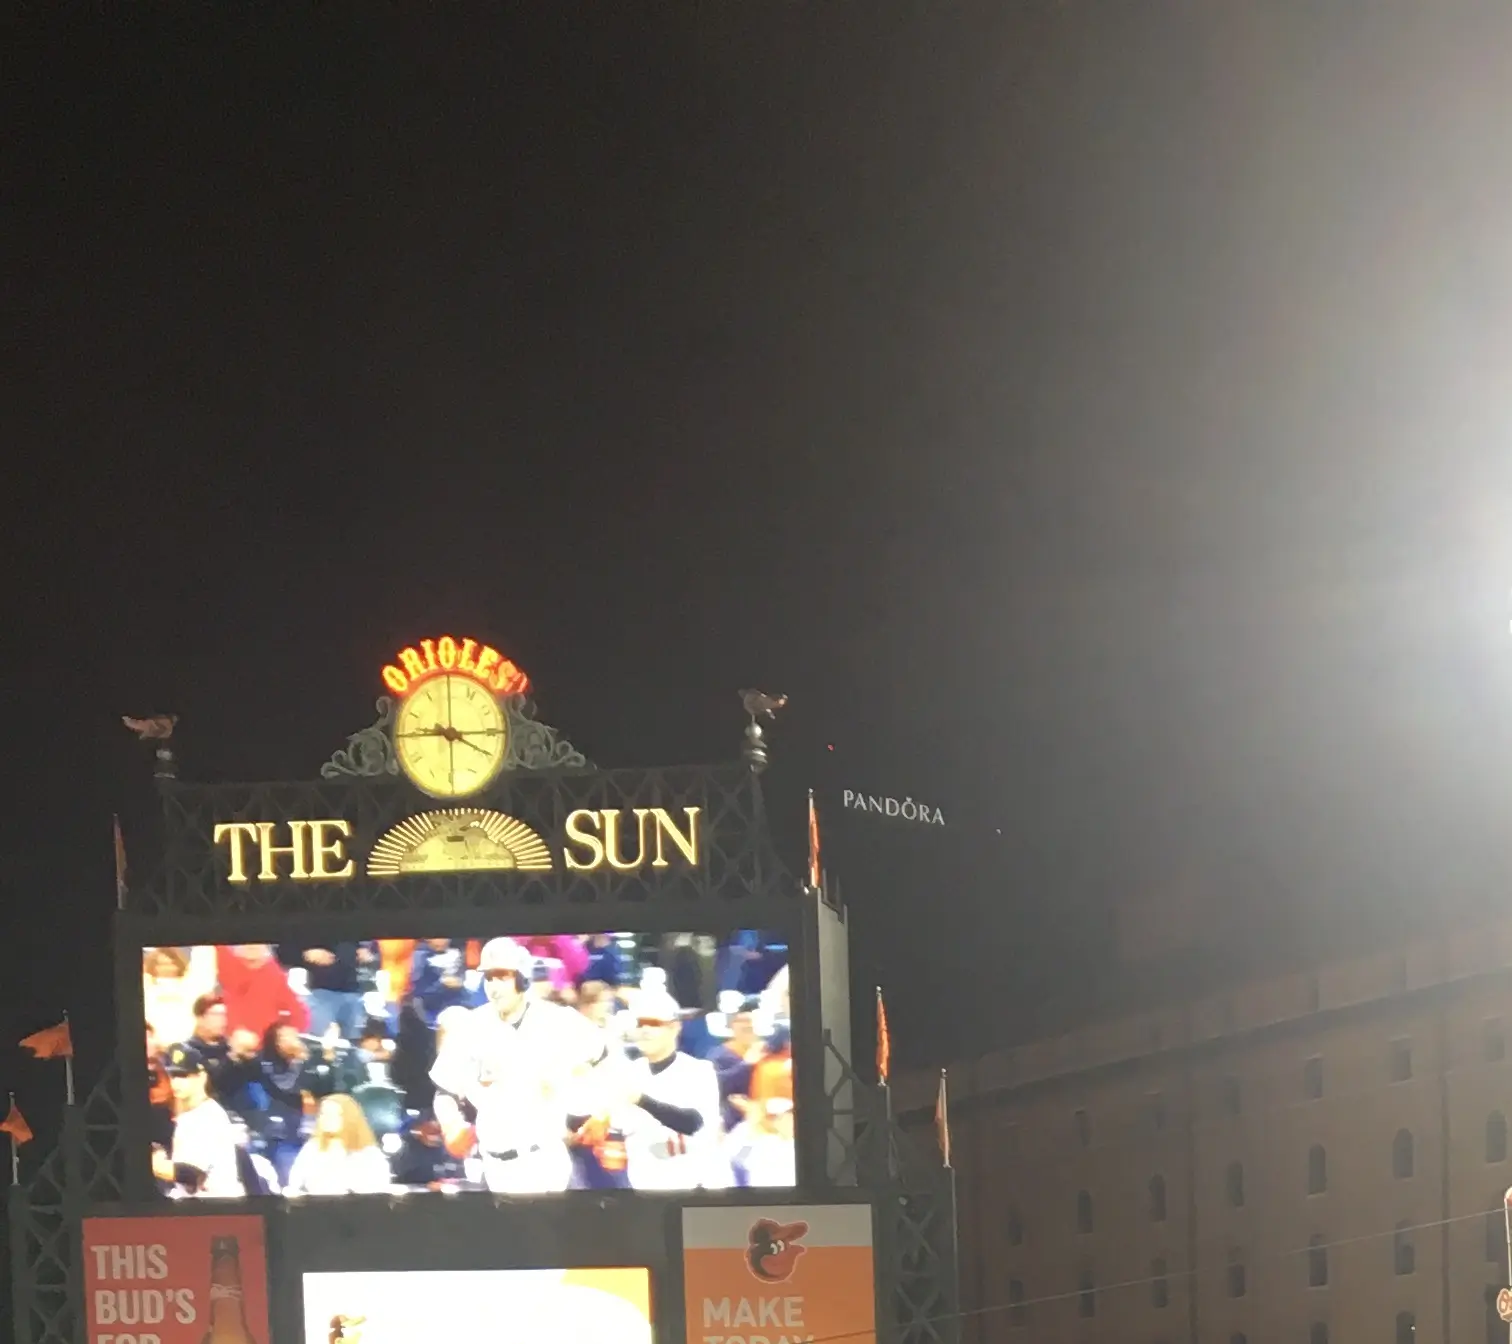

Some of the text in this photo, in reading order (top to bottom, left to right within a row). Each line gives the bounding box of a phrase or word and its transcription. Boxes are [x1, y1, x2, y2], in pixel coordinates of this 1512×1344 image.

[213, 806, 700, 881] THE SUN
[90, 1244, 169, 1281] THIS
[94, 1288, 197, 1325] BUD'S
[703, 1296, 805, 1328] MAKE
